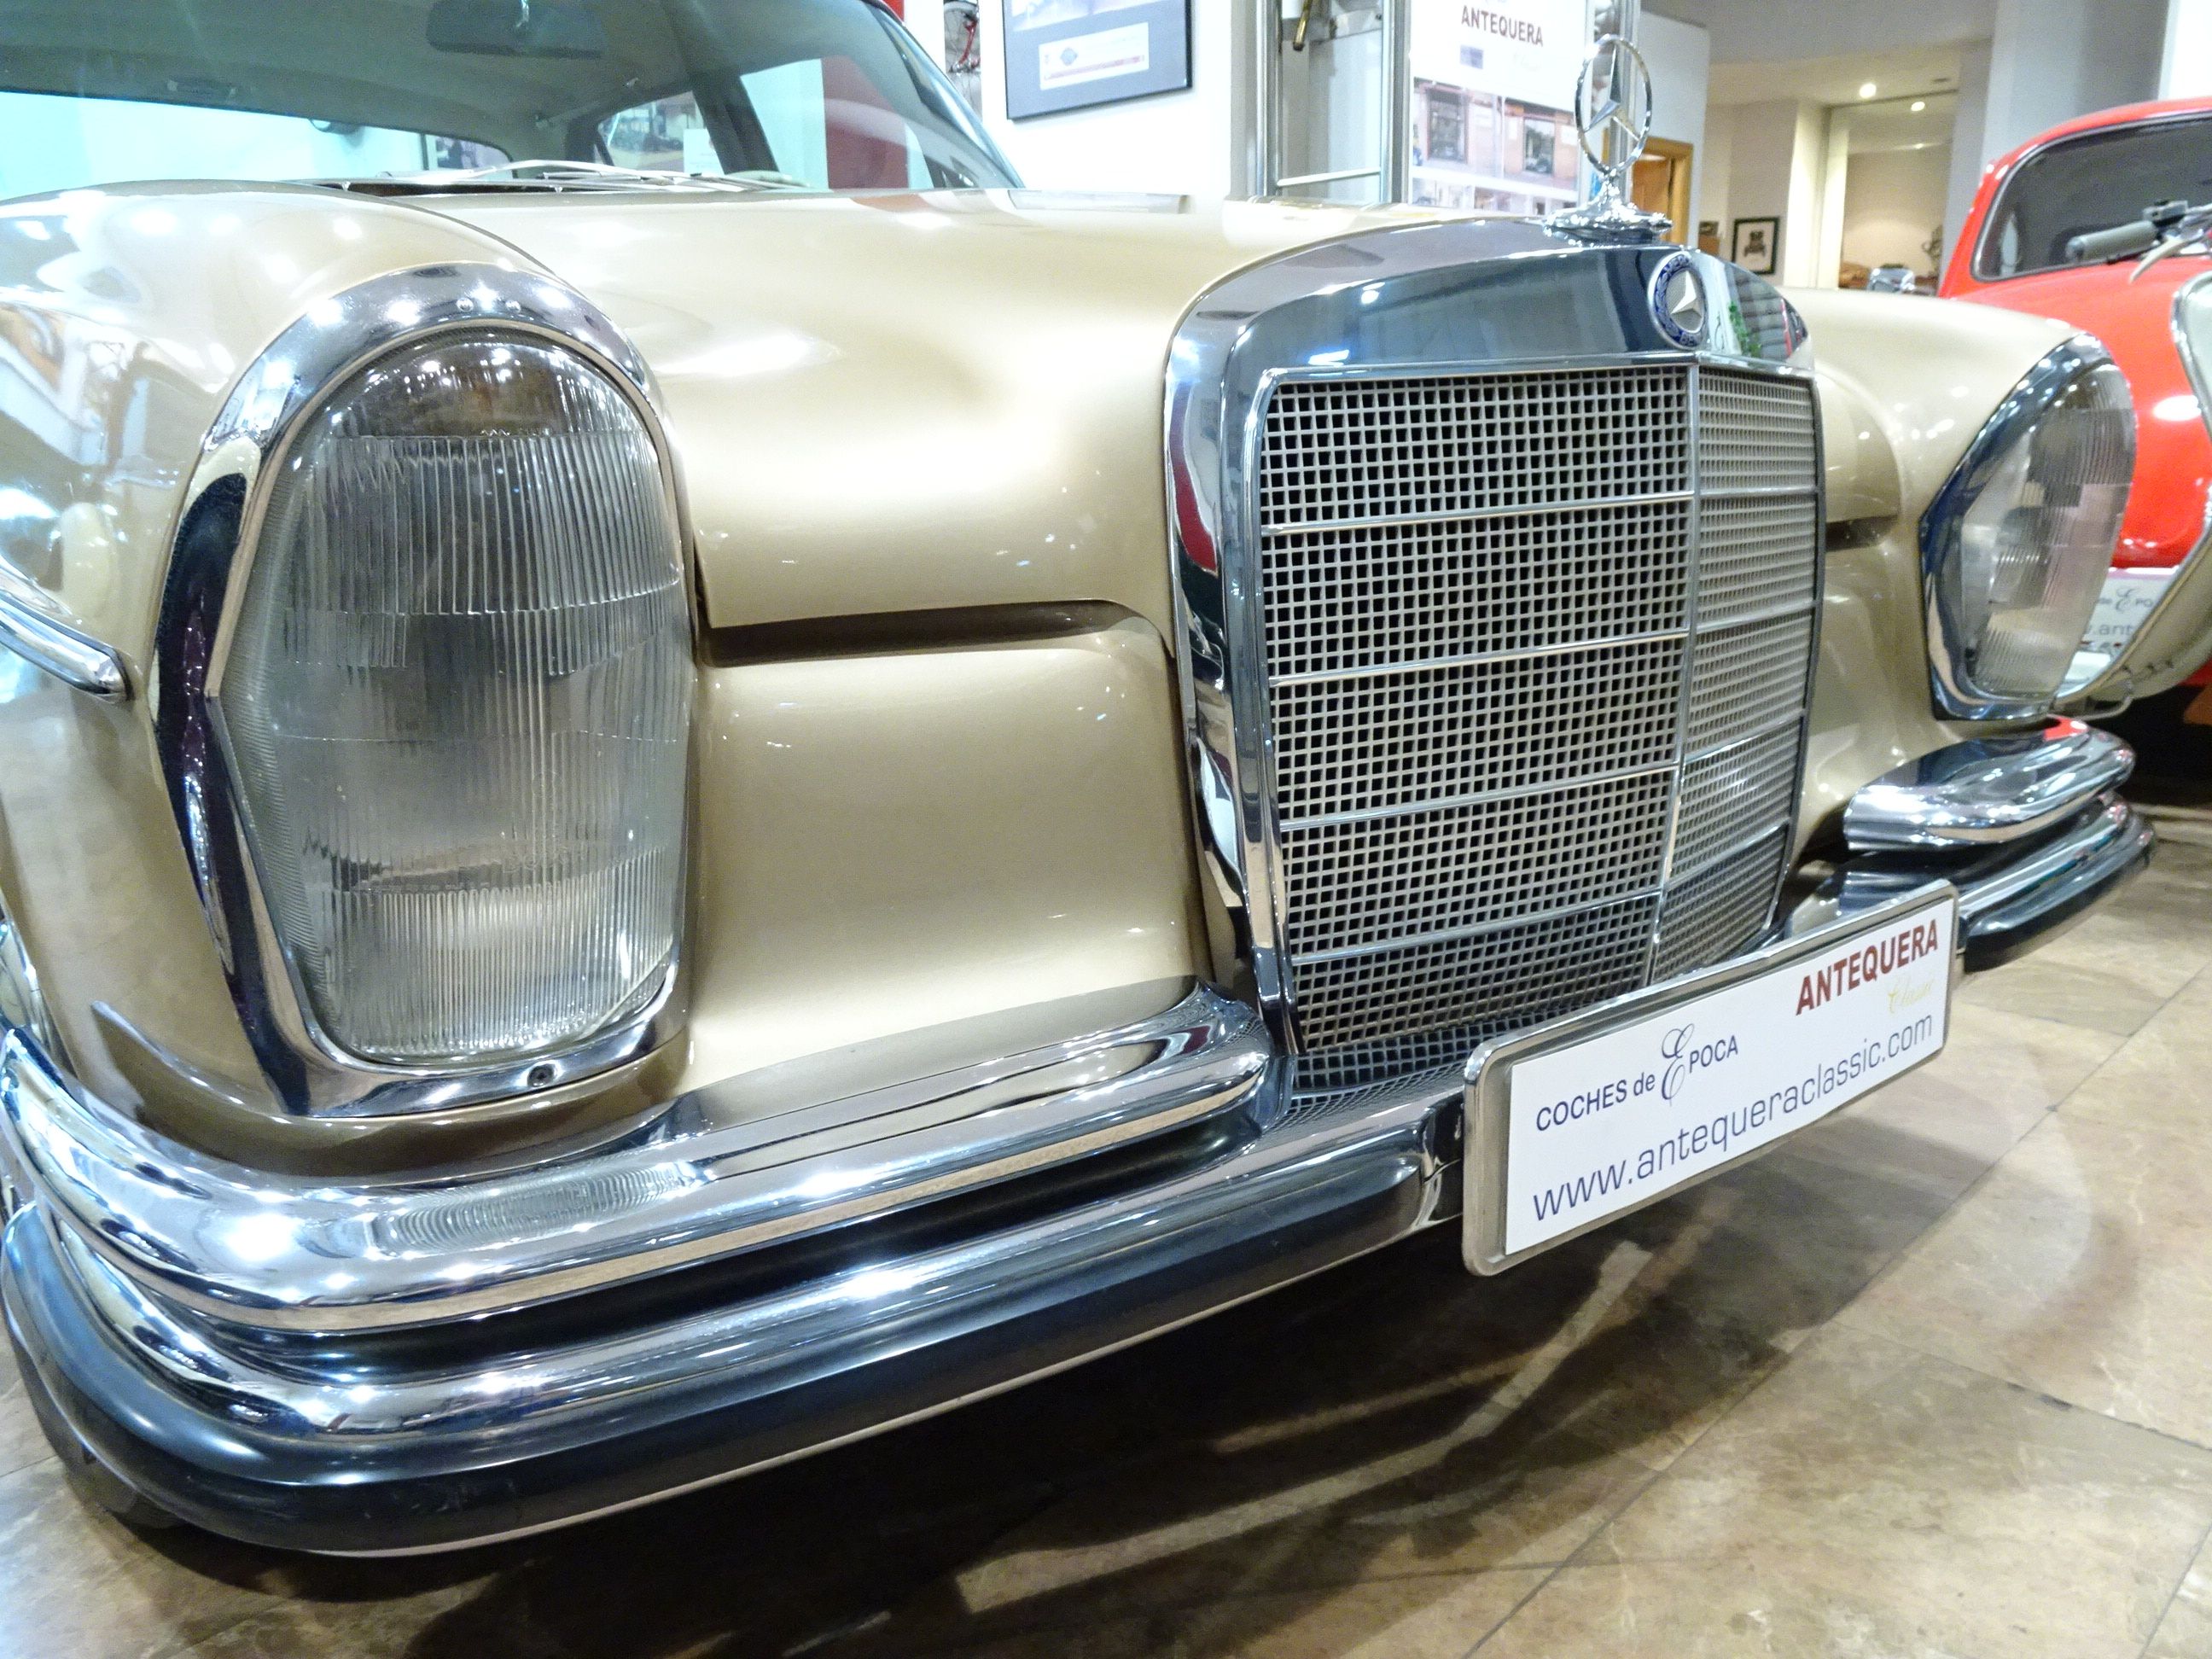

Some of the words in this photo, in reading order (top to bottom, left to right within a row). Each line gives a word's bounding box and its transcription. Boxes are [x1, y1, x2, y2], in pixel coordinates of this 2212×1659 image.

[1461, 5, 1544, 47] ANTEQUERA
[1796, 919, 1938, 1016] ANTEQUERA
[1534, 1014, 1932, 1220] www.antequeraclassic.com
[1536, 1080, 1627, 1132] COCHES
[1633, 1072, 1656, 1097] de
